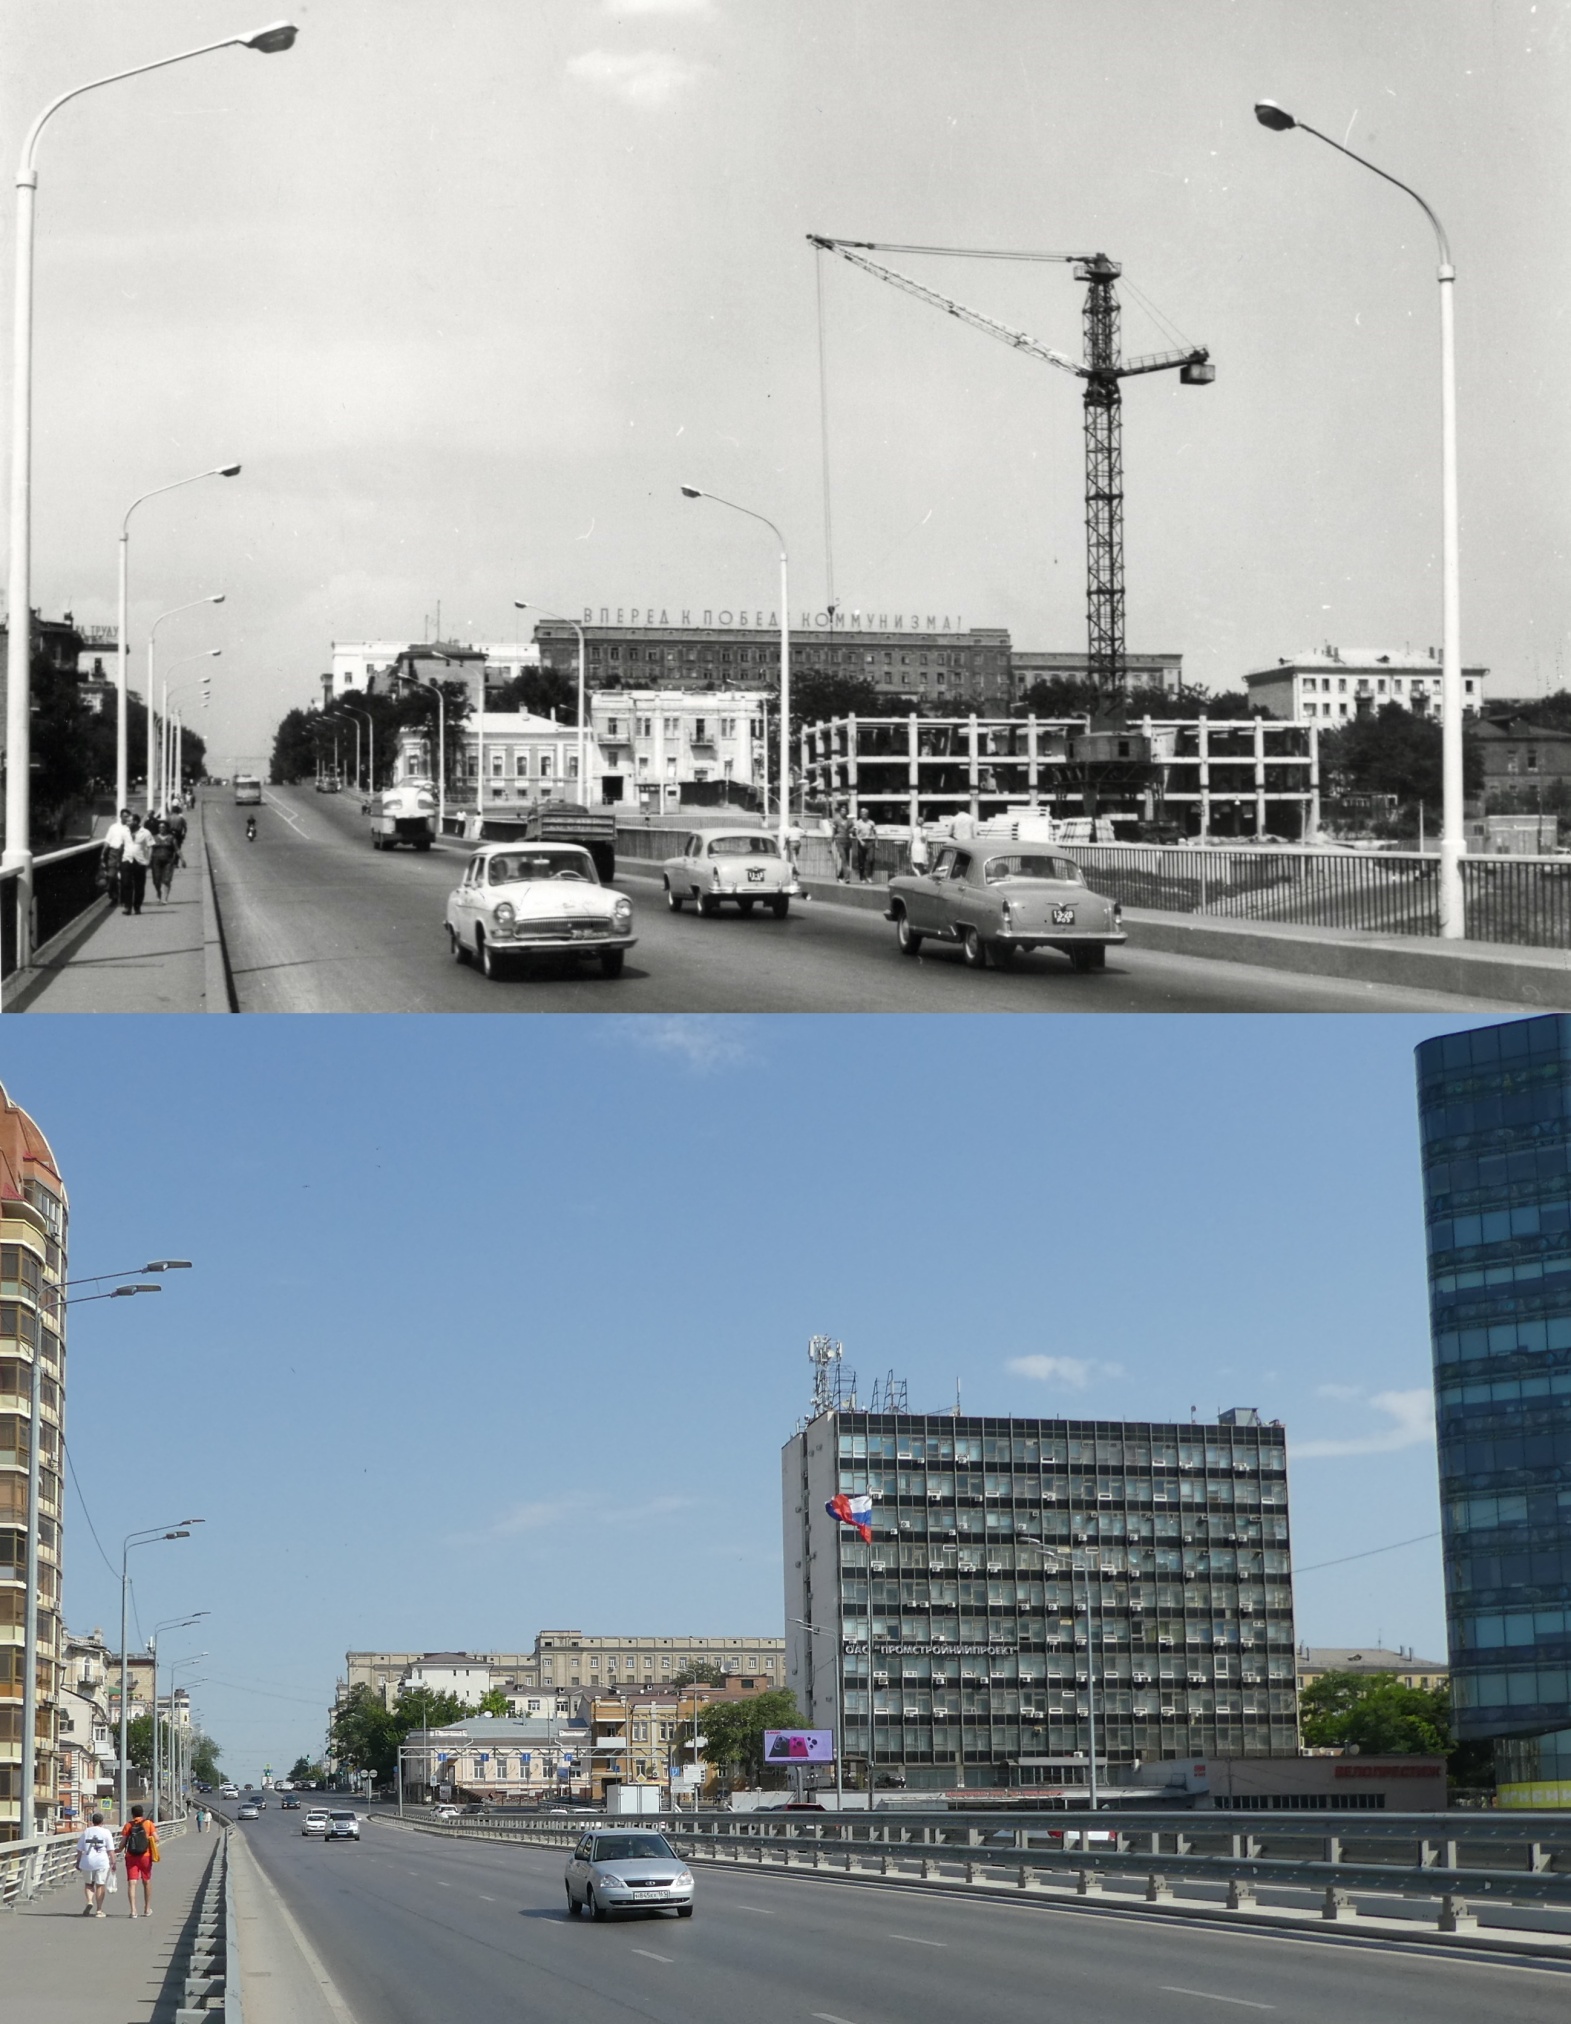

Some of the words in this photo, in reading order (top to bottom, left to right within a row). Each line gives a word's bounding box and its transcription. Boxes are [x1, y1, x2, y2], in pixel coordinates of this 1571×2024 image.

[584, 607, 669, 625] ВПЕРЕД
[682, 610, 691, 625] К
[703, 610, 789, 626] ПОБЕД
[802, 613, 961, 630] КОММУНИЗМА!
[91, 625, 119, 637] ТРУДУ
